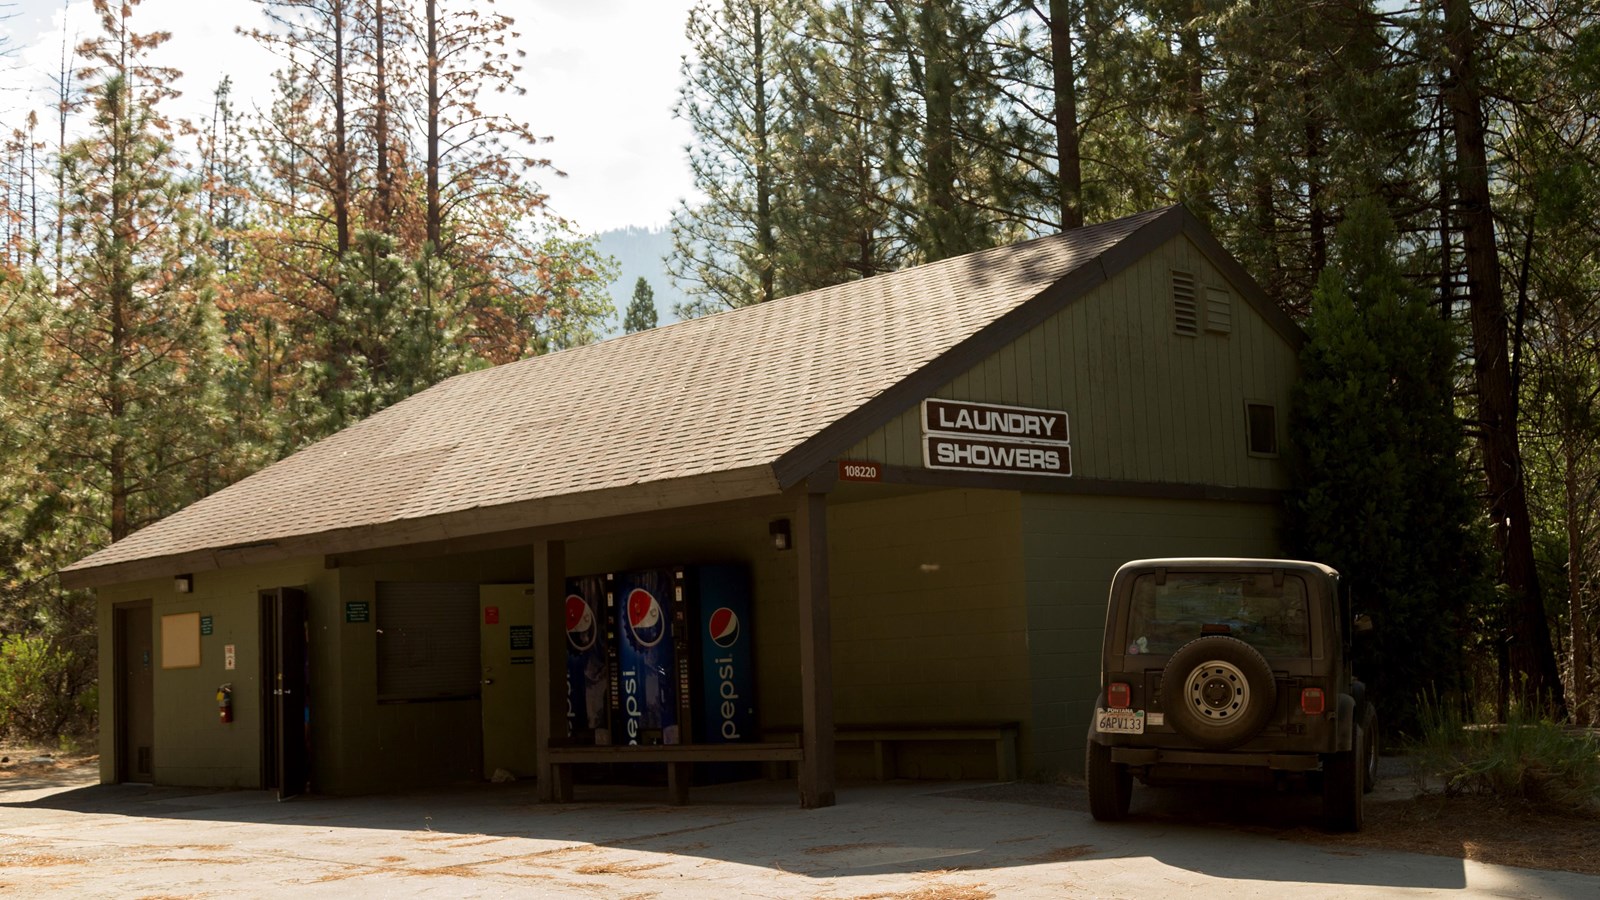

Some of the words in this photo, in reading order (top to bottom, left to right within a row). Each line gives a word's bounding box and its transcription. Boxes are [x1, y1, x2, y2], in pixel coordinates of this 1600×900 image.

[938, 407, 1057, 436] LAUNDRY
[937, 443, 1061, 469] SHOWERS
[844, 465, 877, 478] 108220
[714, 657, 741, 740] pepsi
[1100, 717, 1141, 730] 6APV133
